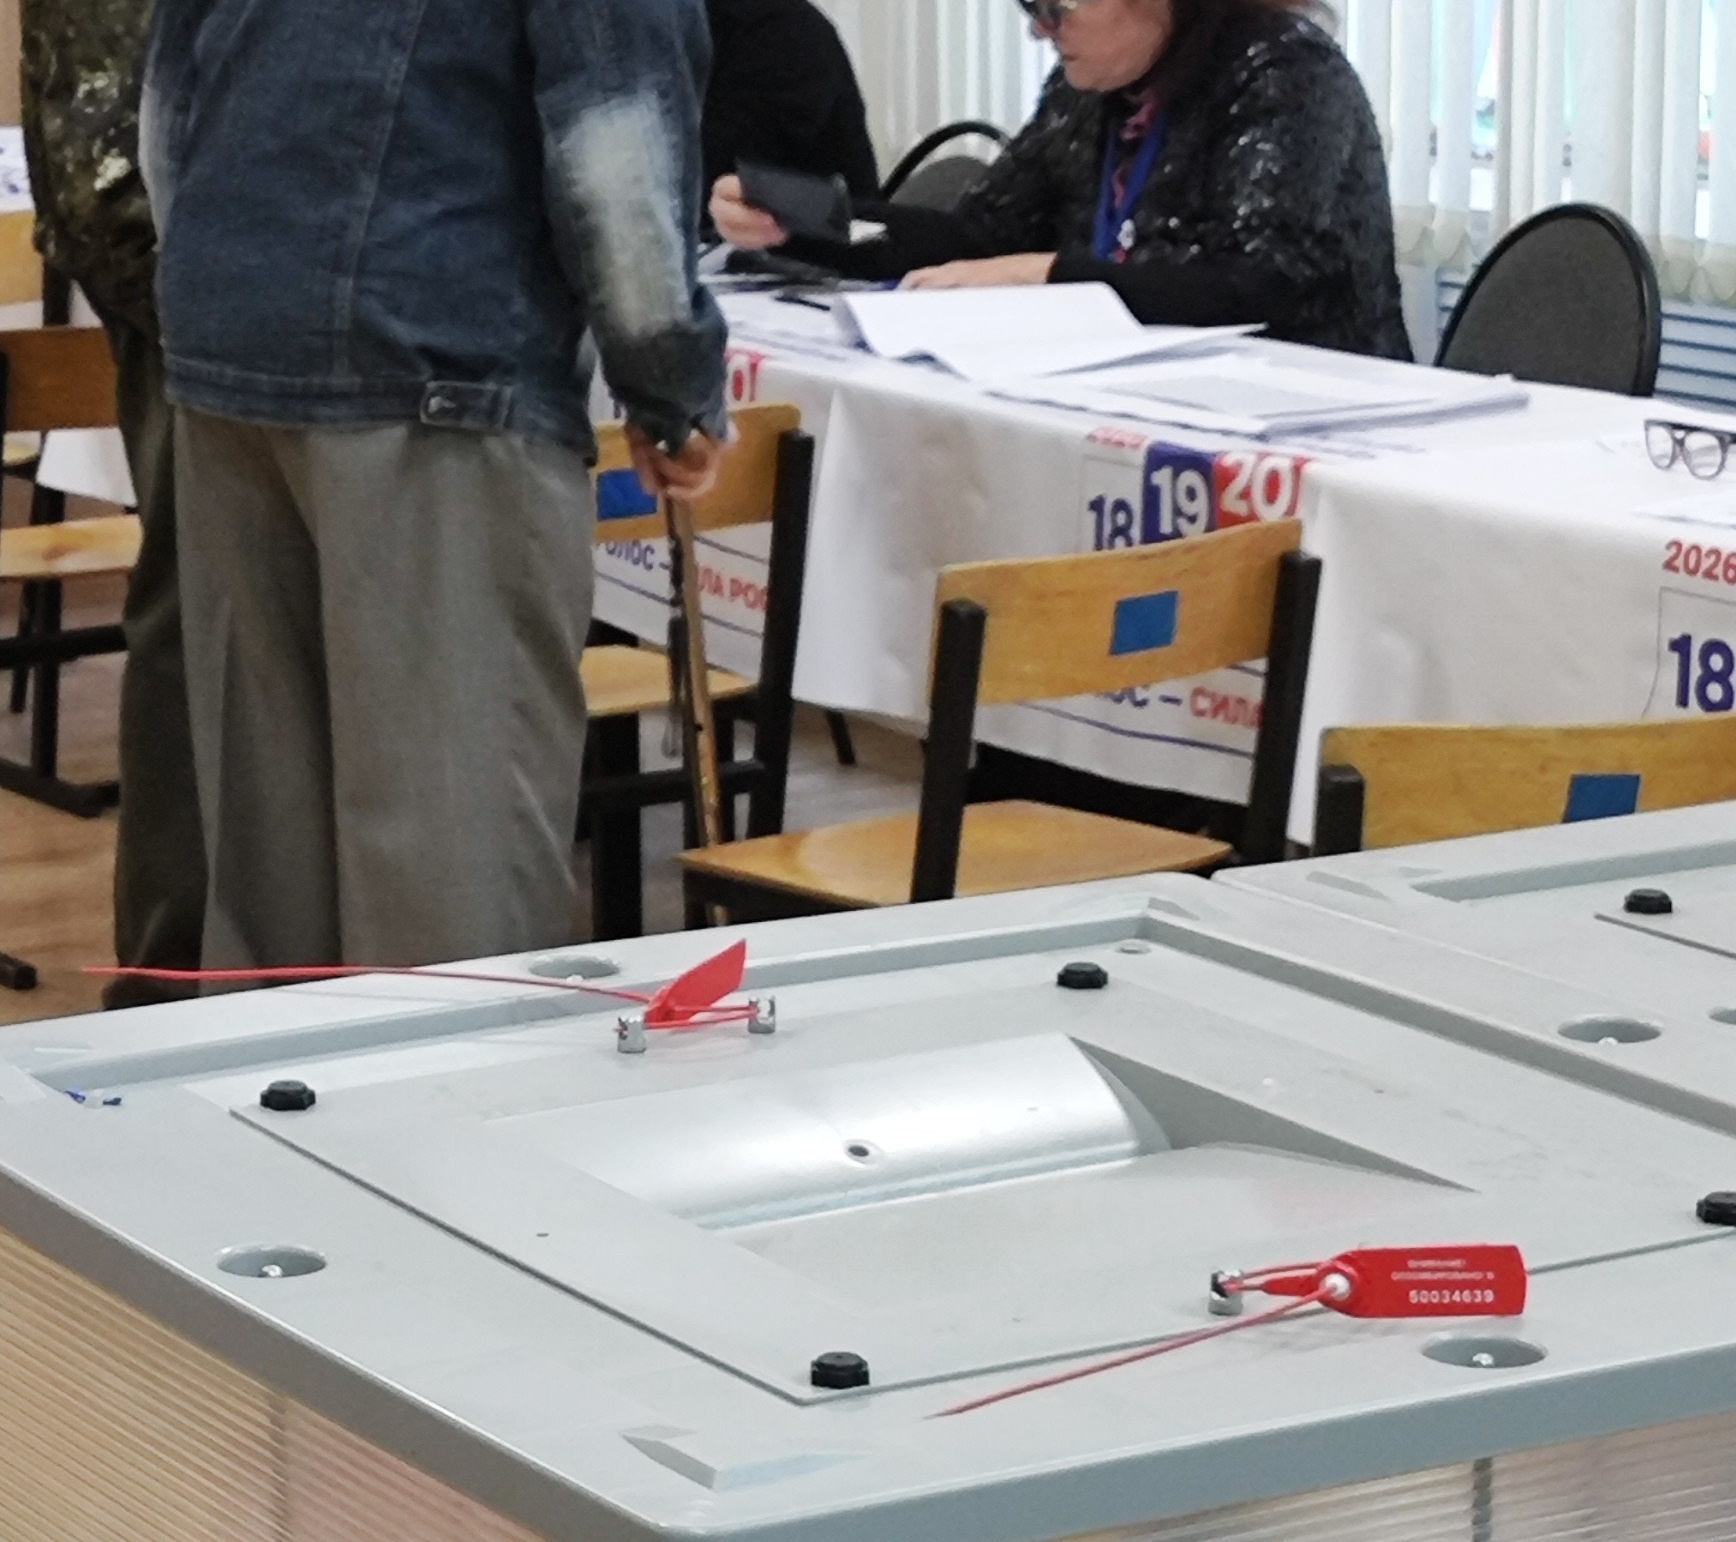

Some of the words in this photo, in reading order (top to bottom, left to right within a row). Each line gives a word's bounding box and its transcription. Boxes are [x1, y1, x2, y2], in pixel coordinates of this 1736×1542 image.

[1088, 493, 1134, 551] 18
[1150, 465, 1210, 538] 19
[1218, 451, 1294, 522] 20
[1663, 540, 1736, 584] 2026
[1668, 632, 1735, 713] 18
